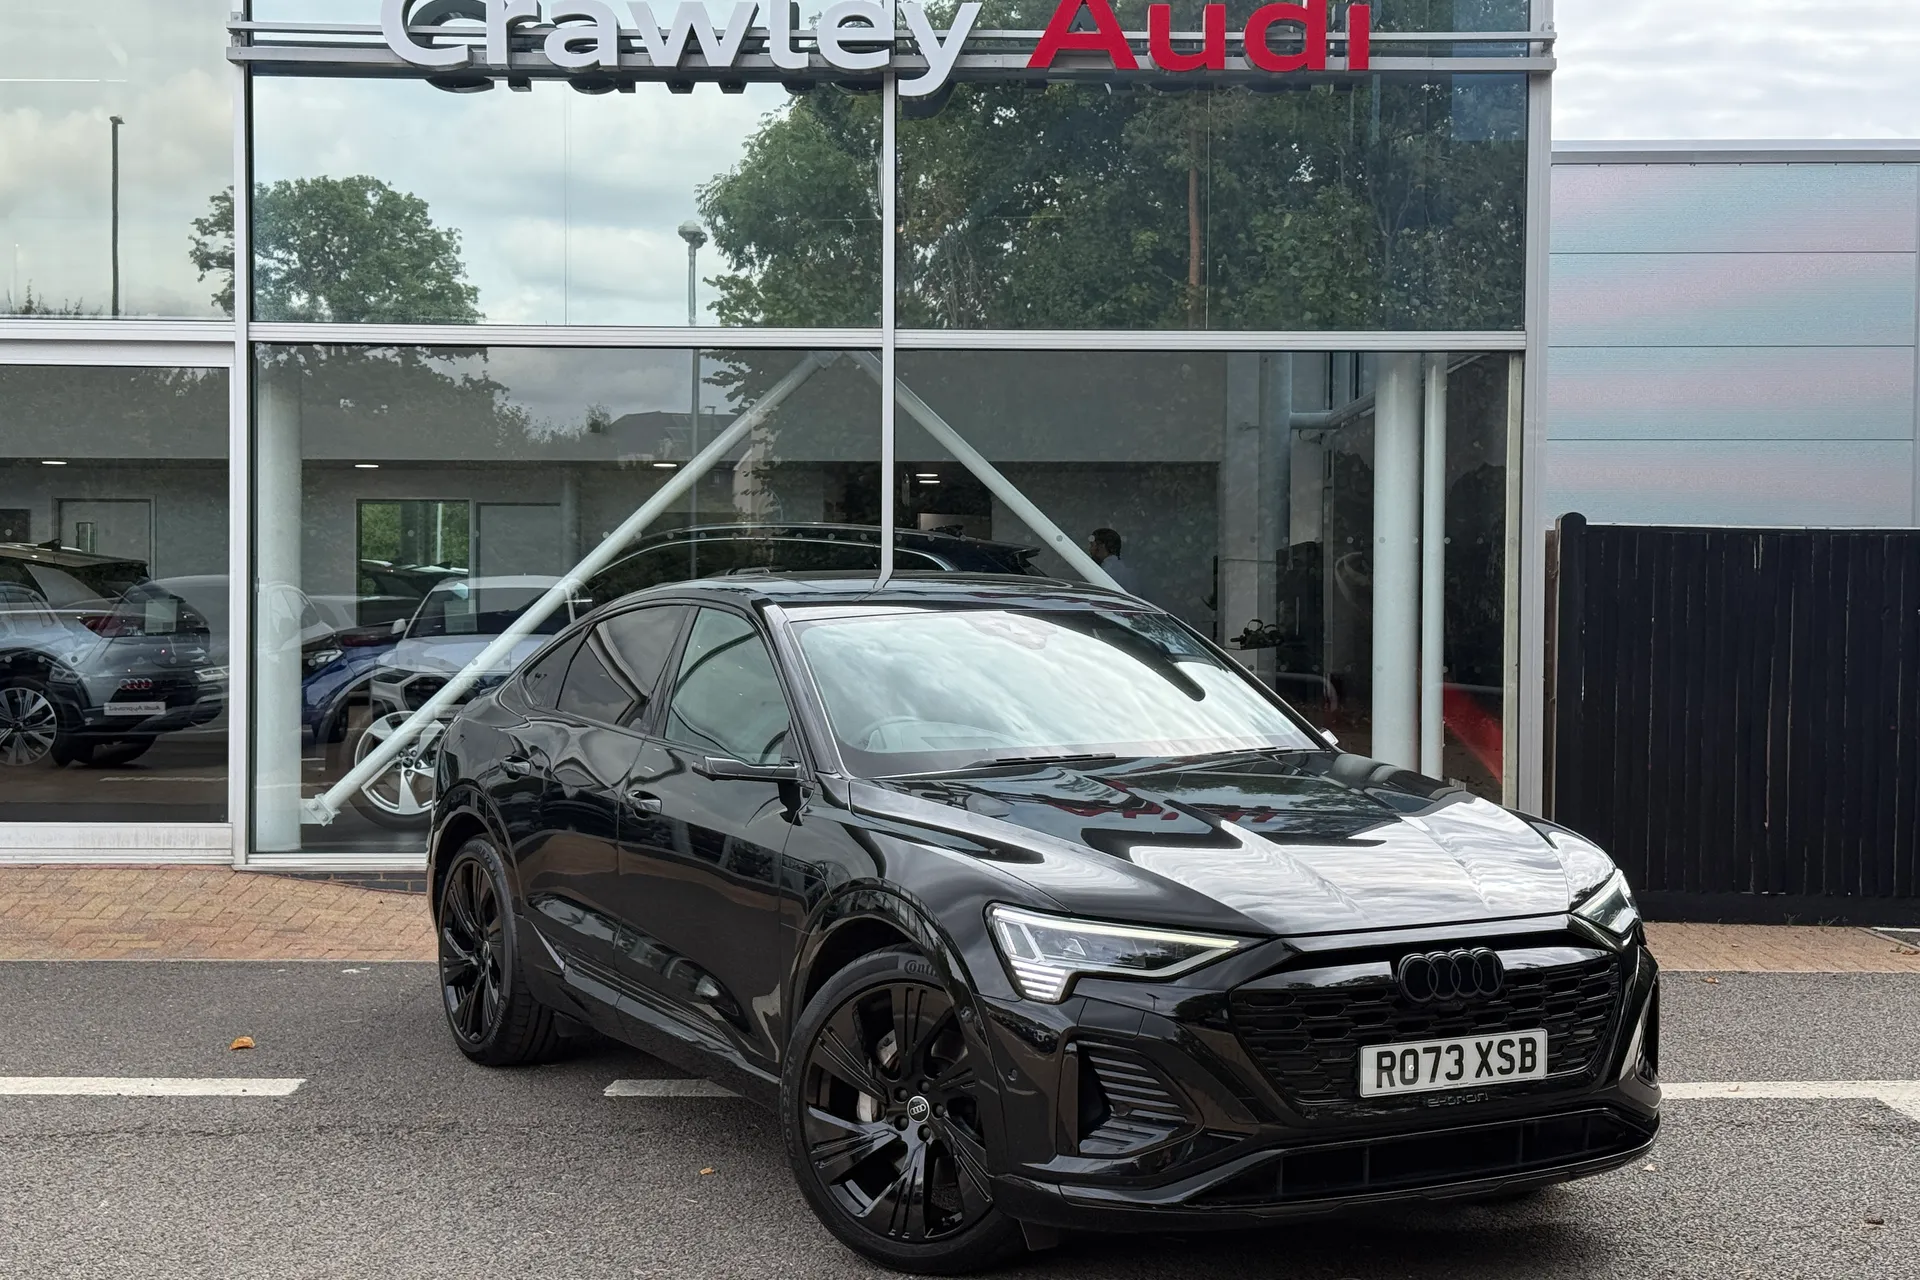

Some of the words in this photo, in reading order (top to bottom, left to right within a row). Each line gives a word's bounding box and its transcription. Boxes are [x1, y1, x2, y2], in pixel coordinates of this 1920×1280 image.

[379, 0, 982, 96] Crawley
[1026, 0, 1370, 72] Audi
[1475, 1036, 1537, 1078] XSB
